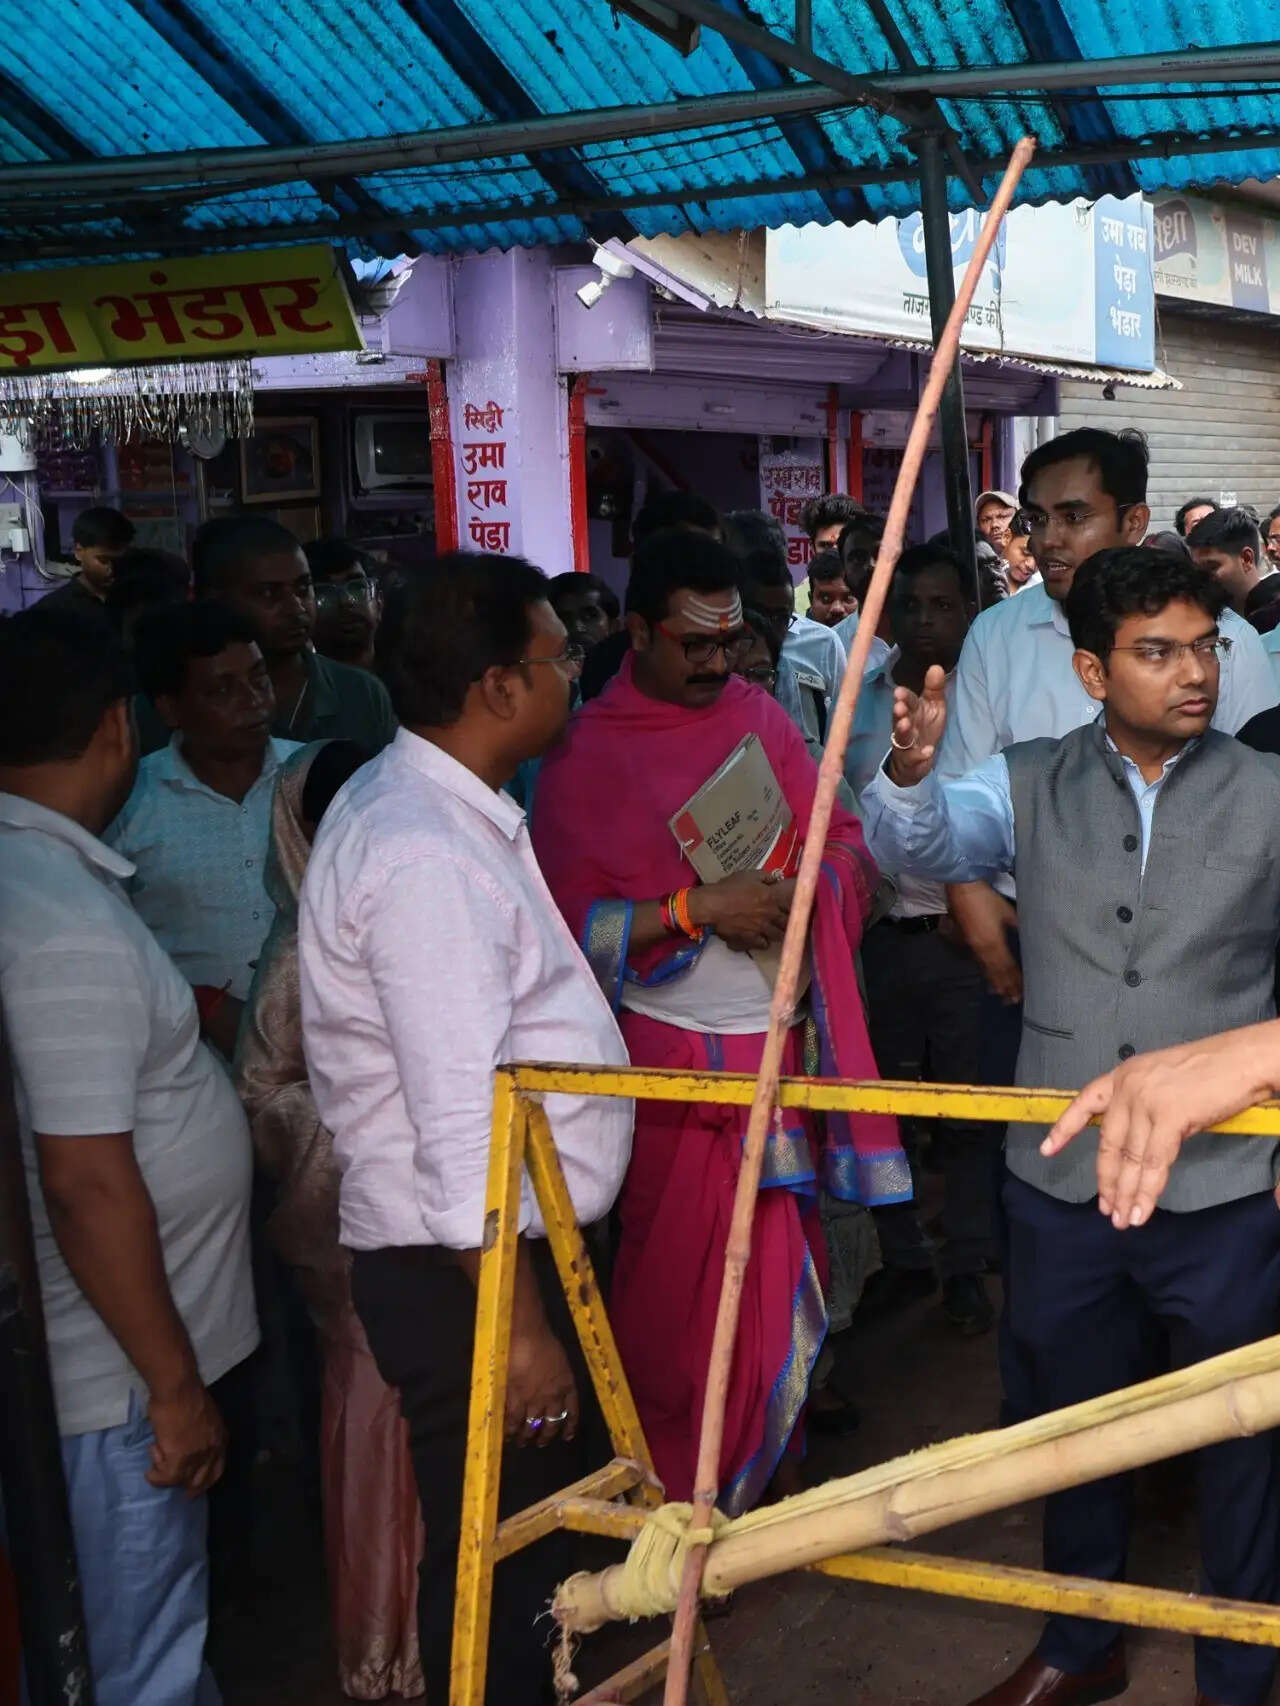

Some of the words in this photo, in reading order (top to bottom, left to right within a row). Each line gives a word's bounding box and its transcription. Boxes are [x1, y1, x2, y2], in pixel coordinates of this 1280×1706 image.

[1101, 215, 1125, 248] उमा
[1233, 232, 1258, 256] DEV
[1234, 263, 1264, 287] MILK
[94, 270, 333, 345] भंडार
[461, 442, 507, 475] उमा
[467, 480, 507, 511] राव
[468, 516, 511, 554] पेड़ा
[706, 810, 742, 850] FLYLEAF
